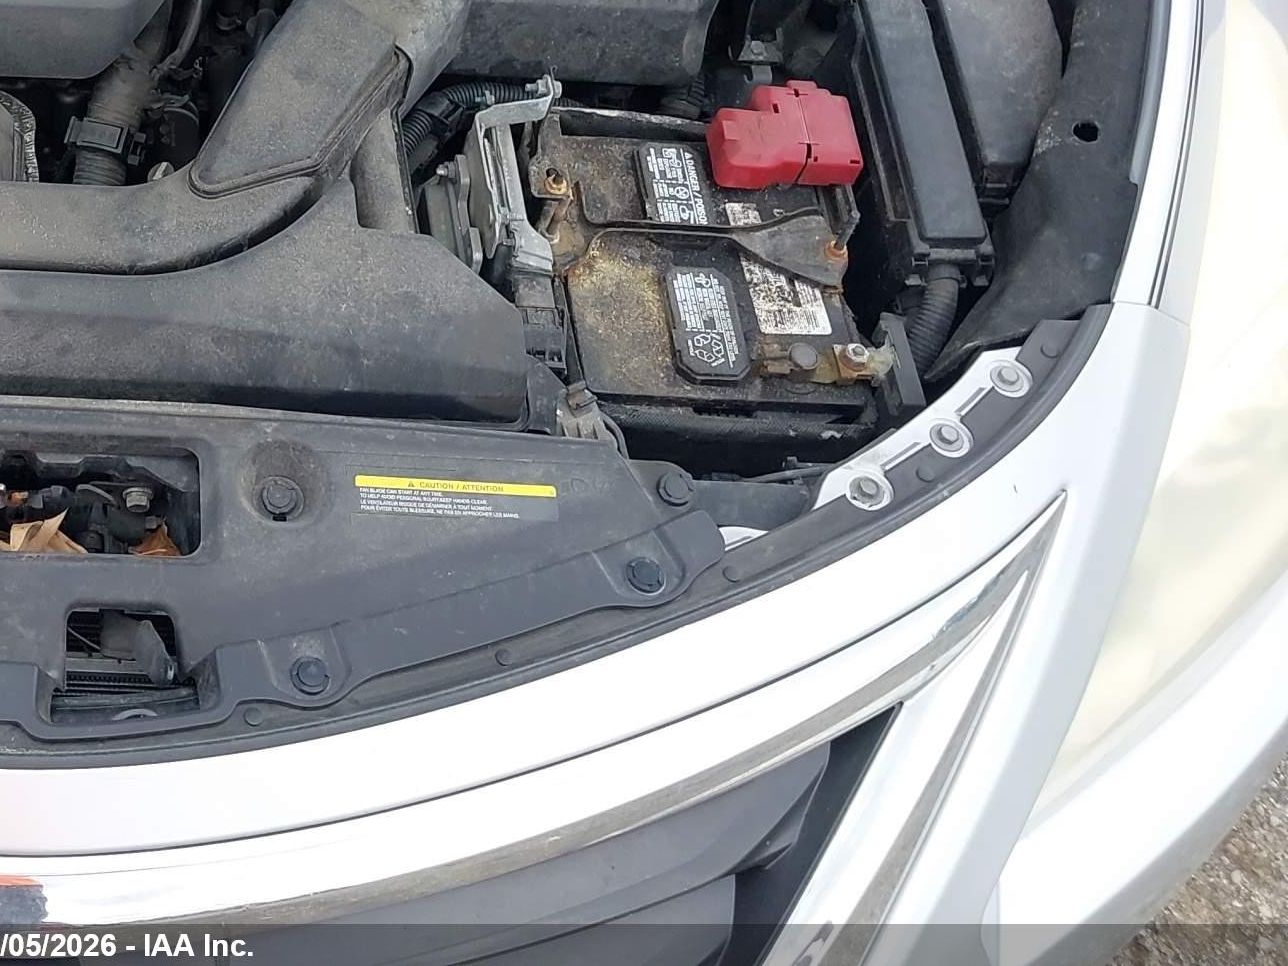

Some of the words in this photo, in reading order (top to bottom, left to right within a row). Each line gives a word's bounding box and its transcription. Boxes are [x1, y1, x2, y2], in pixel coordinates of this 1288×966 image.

[686, 159, 700, 191] DANGER
[419, 481, 454, 490] CAUTION
[462, 485, 504, 493] ATTENTION
